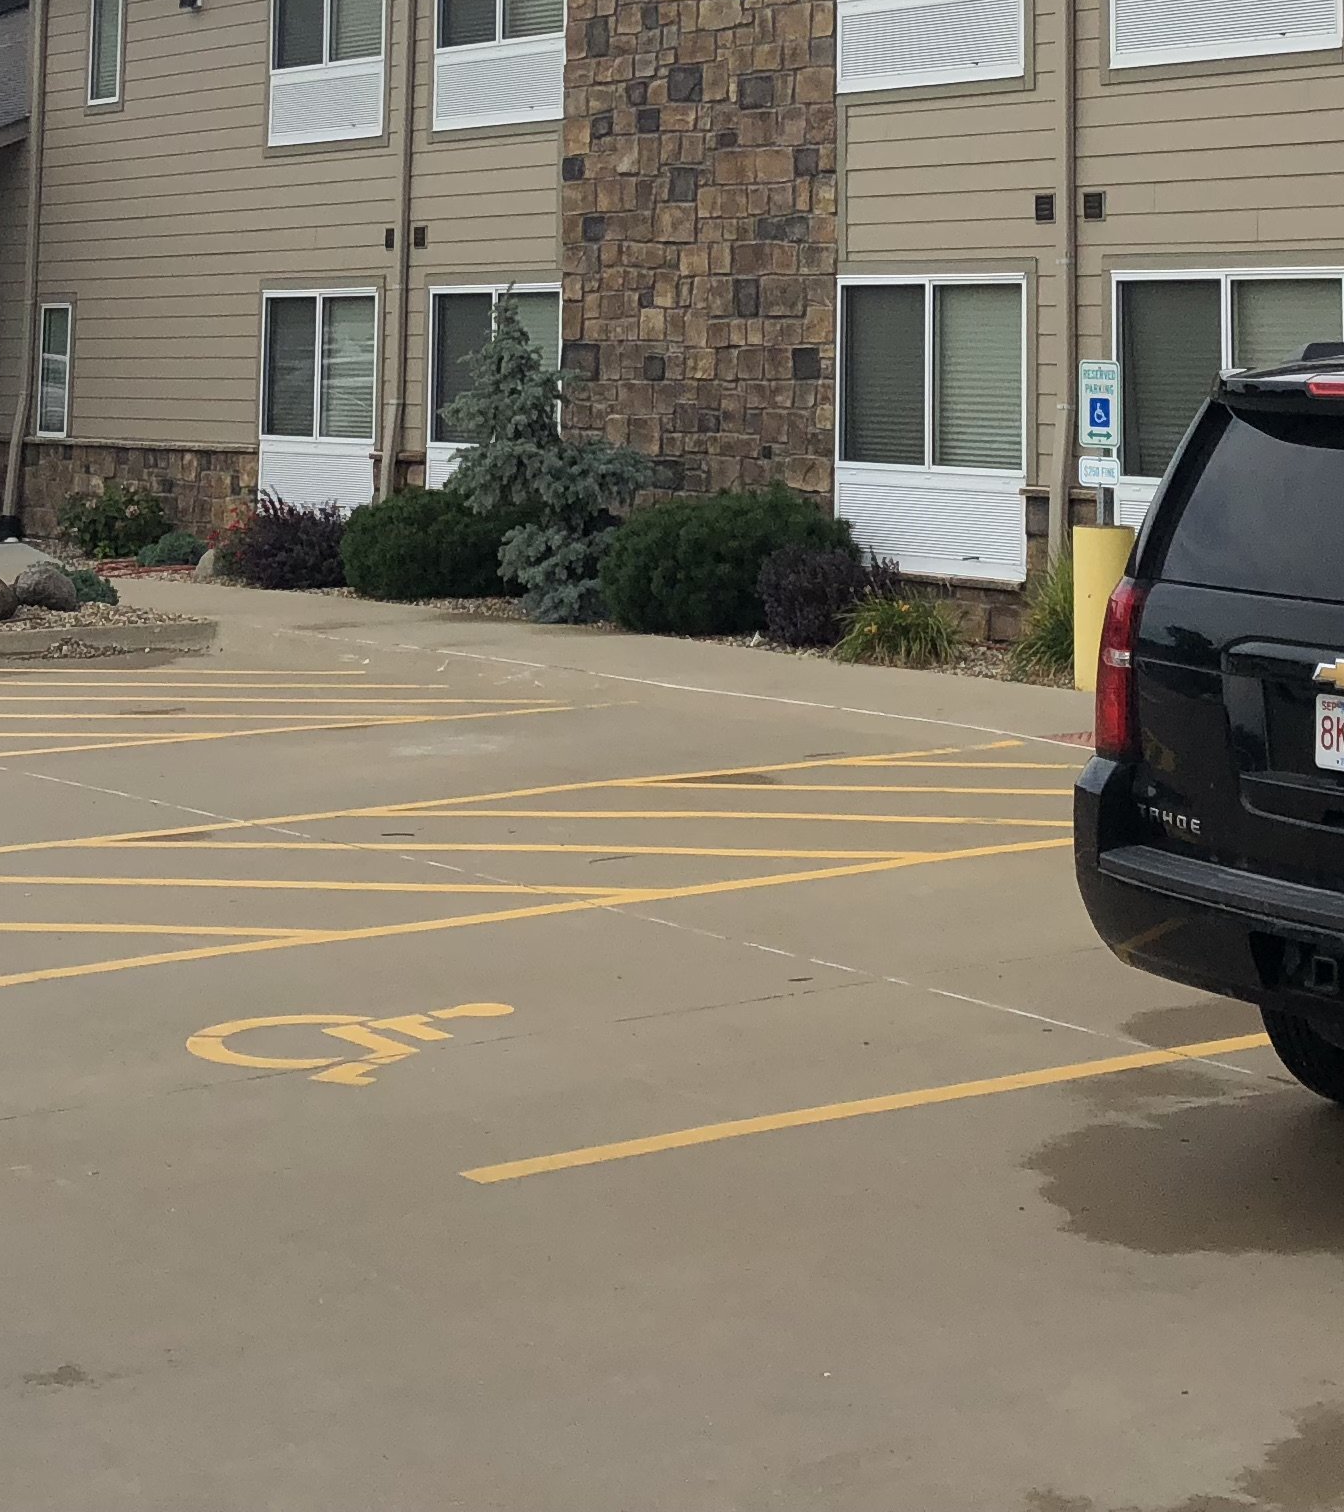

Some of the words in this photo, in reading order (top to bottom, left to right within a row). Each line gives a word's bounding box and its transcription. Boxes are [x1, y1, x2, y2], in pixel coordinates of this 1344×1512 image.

[1083, 369, 1116, 380] RESERVED
[1085, 383, 1114, 395] PARKING
[1102, 467, 1116, 479] FINE
[1322, 700, 1336, 711] SEP
[1137, 803, 1201, 835] TAHOE
